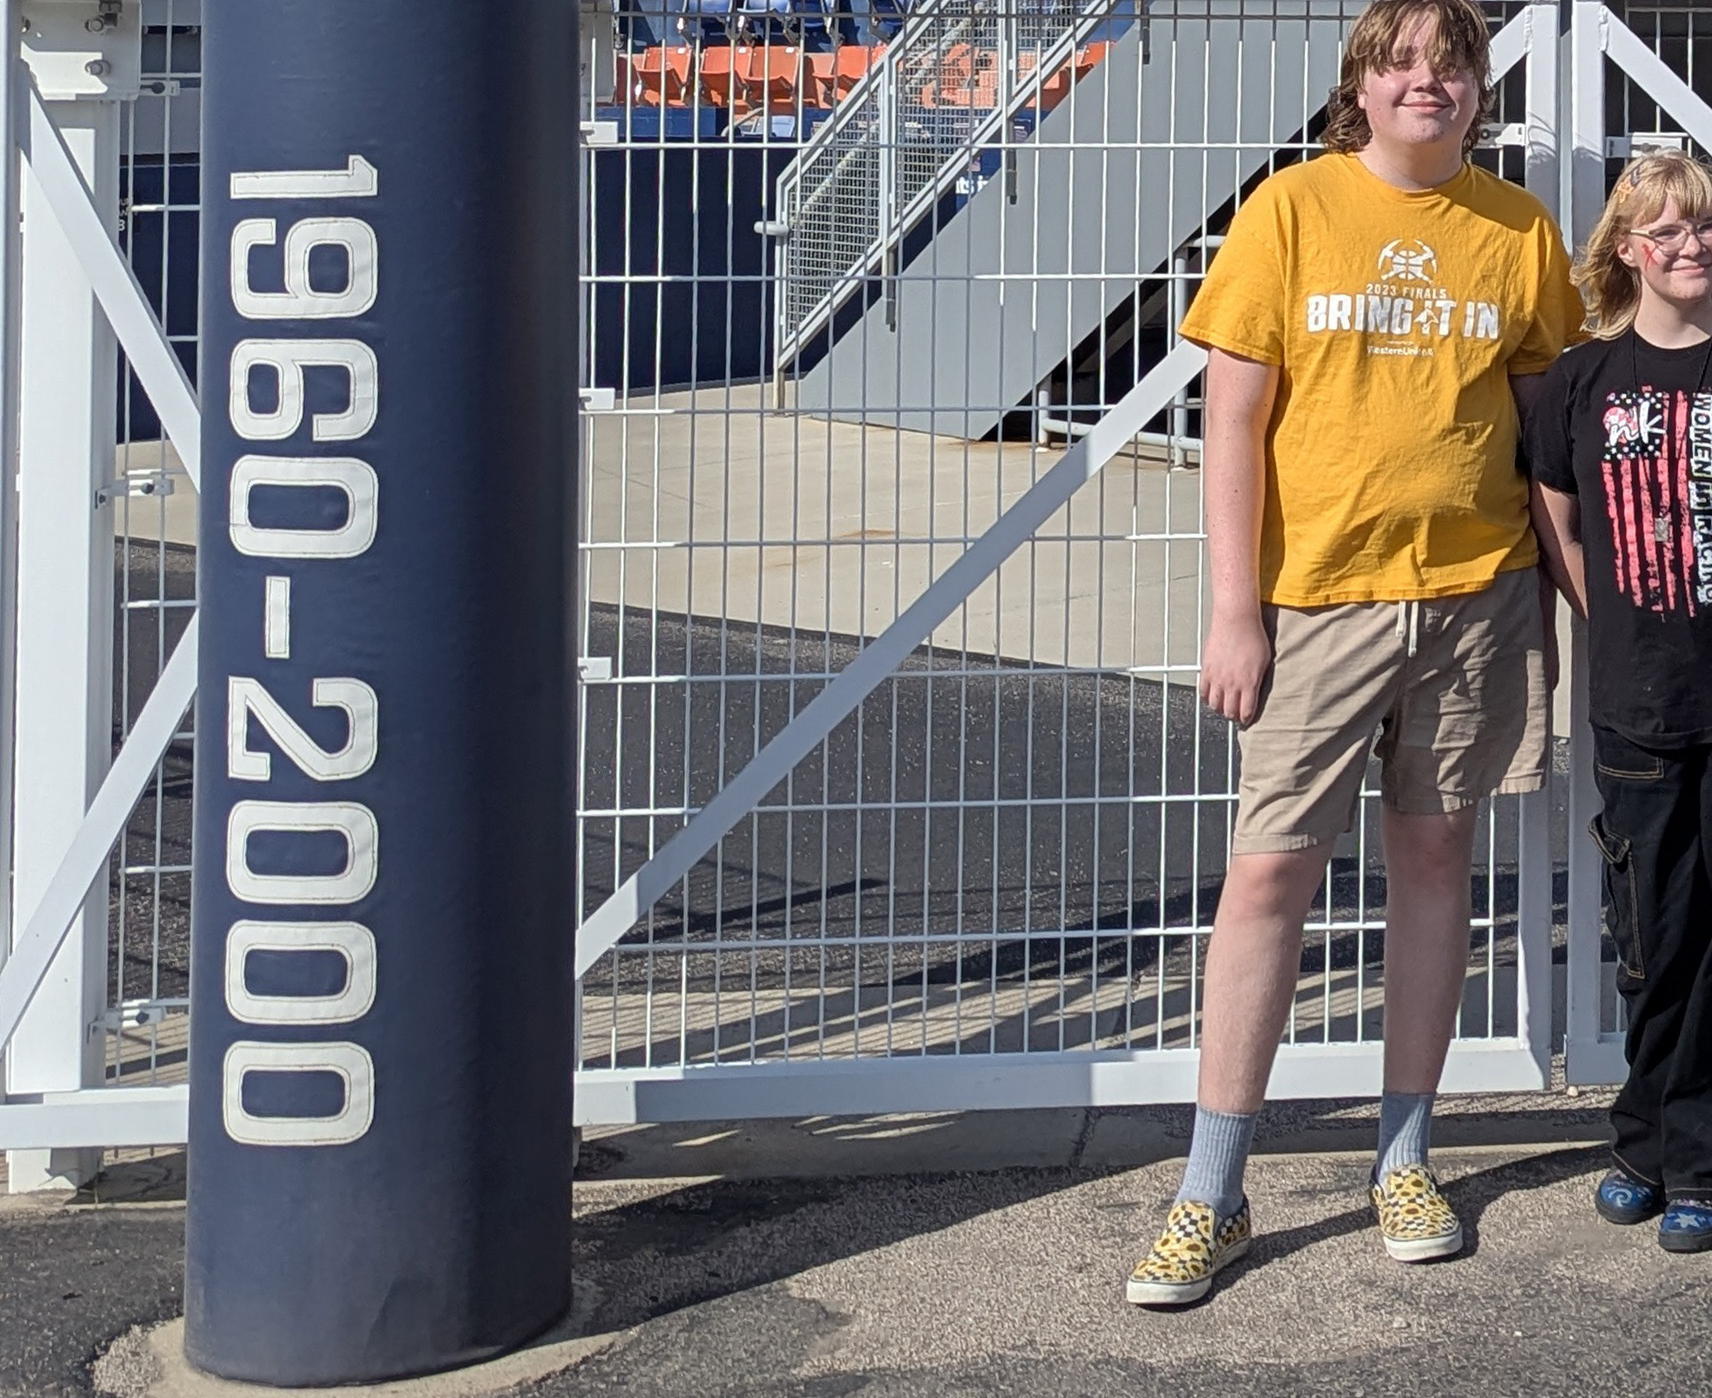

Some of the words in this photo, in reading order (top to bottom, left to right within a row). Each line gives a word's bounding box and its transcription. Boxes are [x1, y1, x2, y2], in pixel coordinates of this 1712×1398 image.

[1366, 283, 1397, 296] 2023
[1307, 294, 1414, 335] BRING
[1420, 298, 1457, 338] IT
[1463, 302, 1499, 339] IN
[222, 154, 379, 1146] 1960-2000
